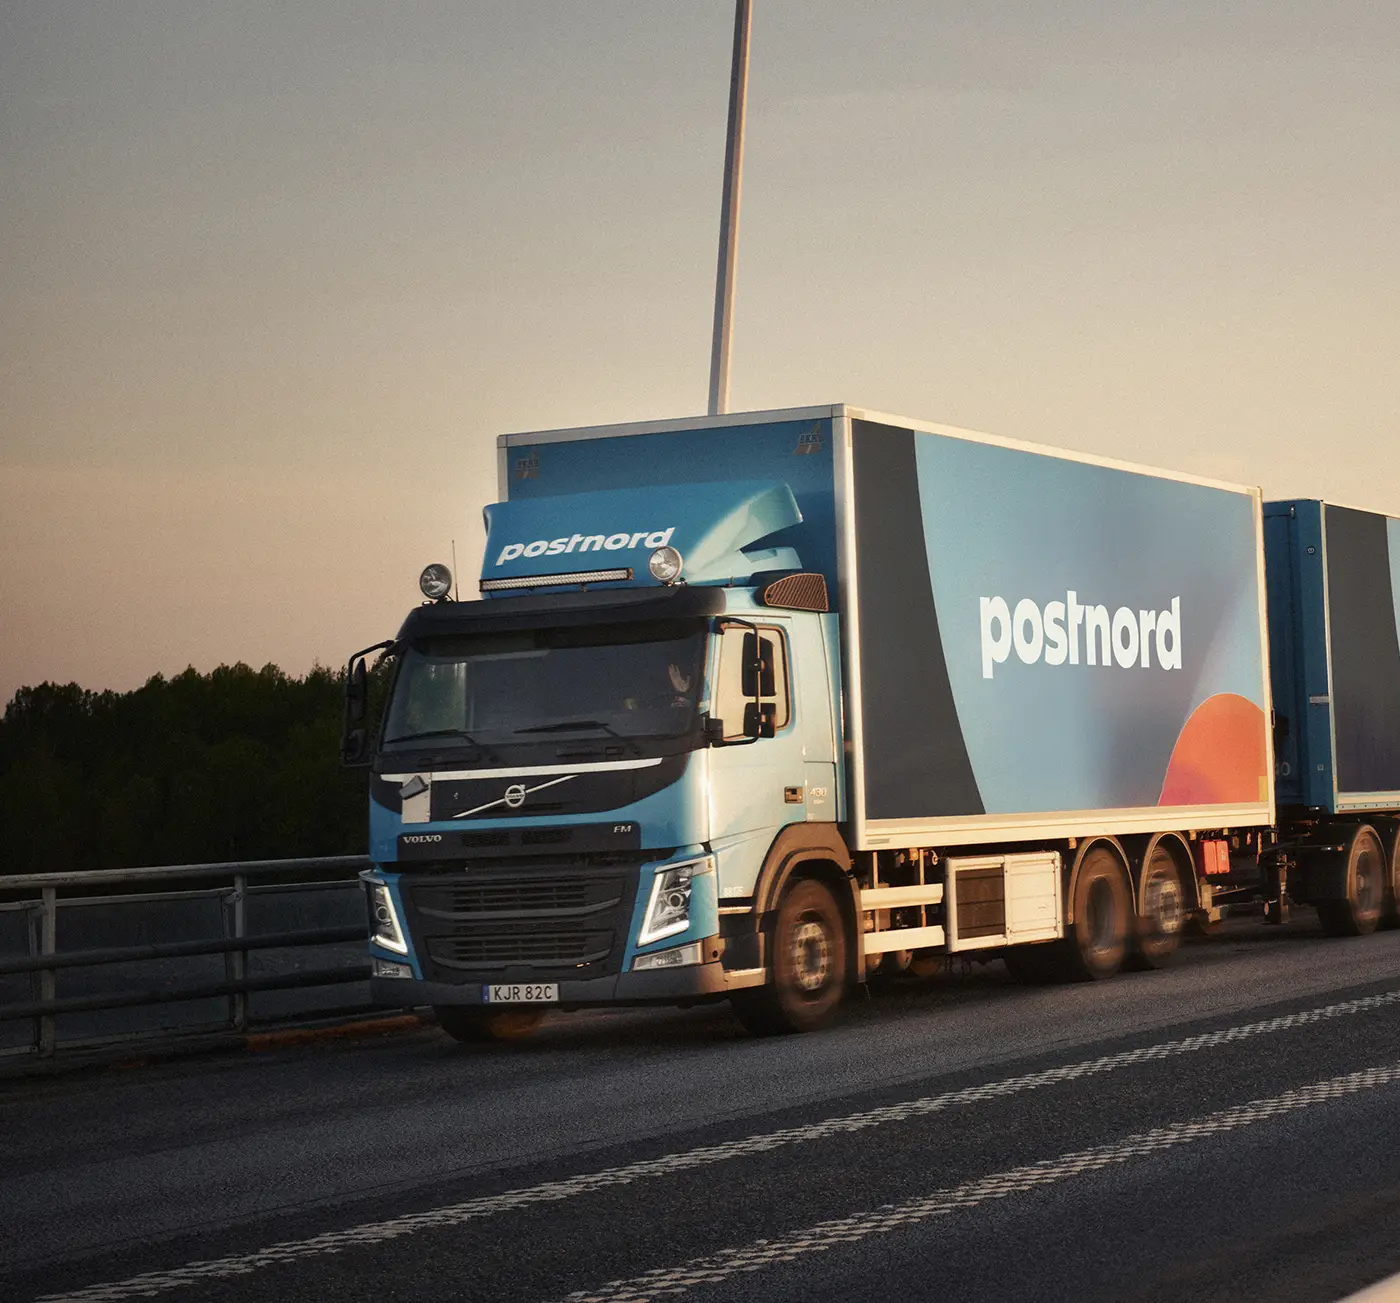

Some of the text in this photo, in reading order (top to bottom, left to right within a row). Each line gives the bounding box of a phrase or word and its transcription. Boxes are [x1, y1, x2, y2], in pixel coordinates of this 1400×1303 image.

[496, 527, 675, 566] postnord
[980, 590, 1182, 679] postnord
[810, 787, 827, 796] 430
[614, 825, 631, 833] FM
[403, 835, 442, 844] VOLVO
[494, 986, 552, 1001] KJR 82C
